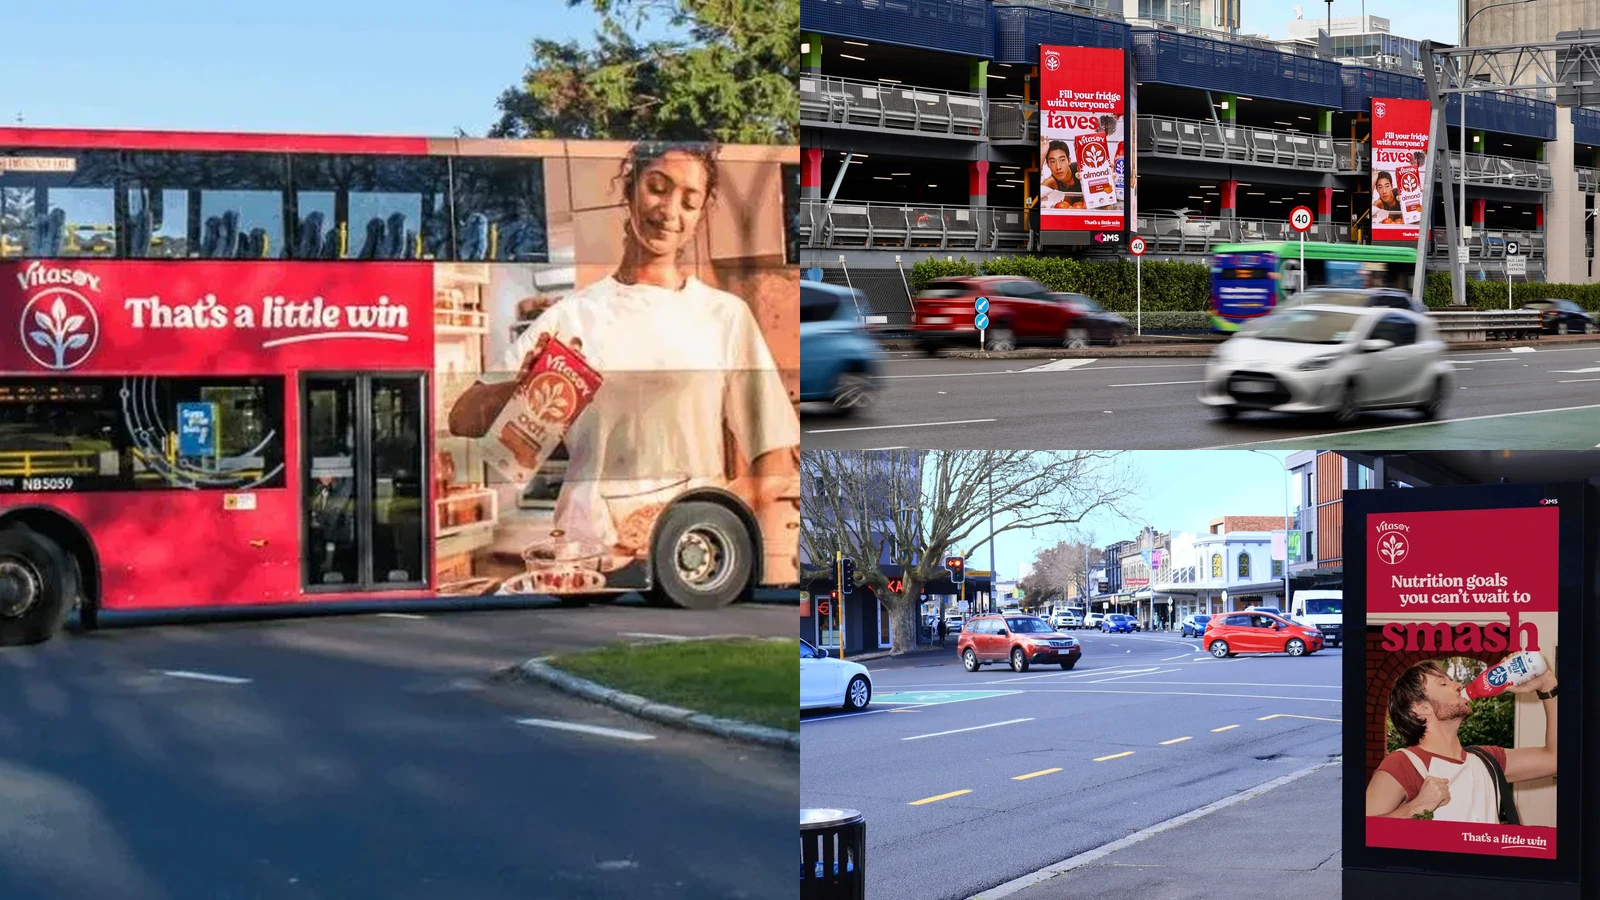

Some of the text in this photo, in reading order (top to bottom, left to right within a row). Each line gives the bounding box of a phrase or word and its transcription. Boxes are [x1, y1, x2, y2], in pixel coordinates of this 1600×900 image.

[1059, 89, 1121, 102] Fill your fridge
[1047, 98, 1115, 110] with everyone's
[1047, 110, 1099, 130] faves
[1078, 135, 1105, 146] Vitasoy
[1376, 138, 1424, 148] with everyone's
[1411, 133, 1429, 142] fridge
[1376, 147, 1412, 163] faves
[1083, 168, 1109, 179] almond
[1401, 193, 1420, 201] almond
[1294, 214, 1308, 224] 40
[1133, 242, 1143, 250] 40
[17, 260, 101, 293] Vitasoy
[124, 294, 409, 328] That's a little win
[545, 353, 592, 397] Vitasoy
[518, 412, 547, 438] oat
[22, 477, 74, 491] NB5059
[1376, 521, 1410, 533] Vitasoy
[1391, 572, 1508, 590] Nutrition goals
[1399, 588, 1531, 607] you can't wait to
[1381, 609, 1541, 652] smash
[1462, 832, 1491, 843] That's
[1501, 834, 1525, 845] little
[1527, 836, 1547, 847] win
